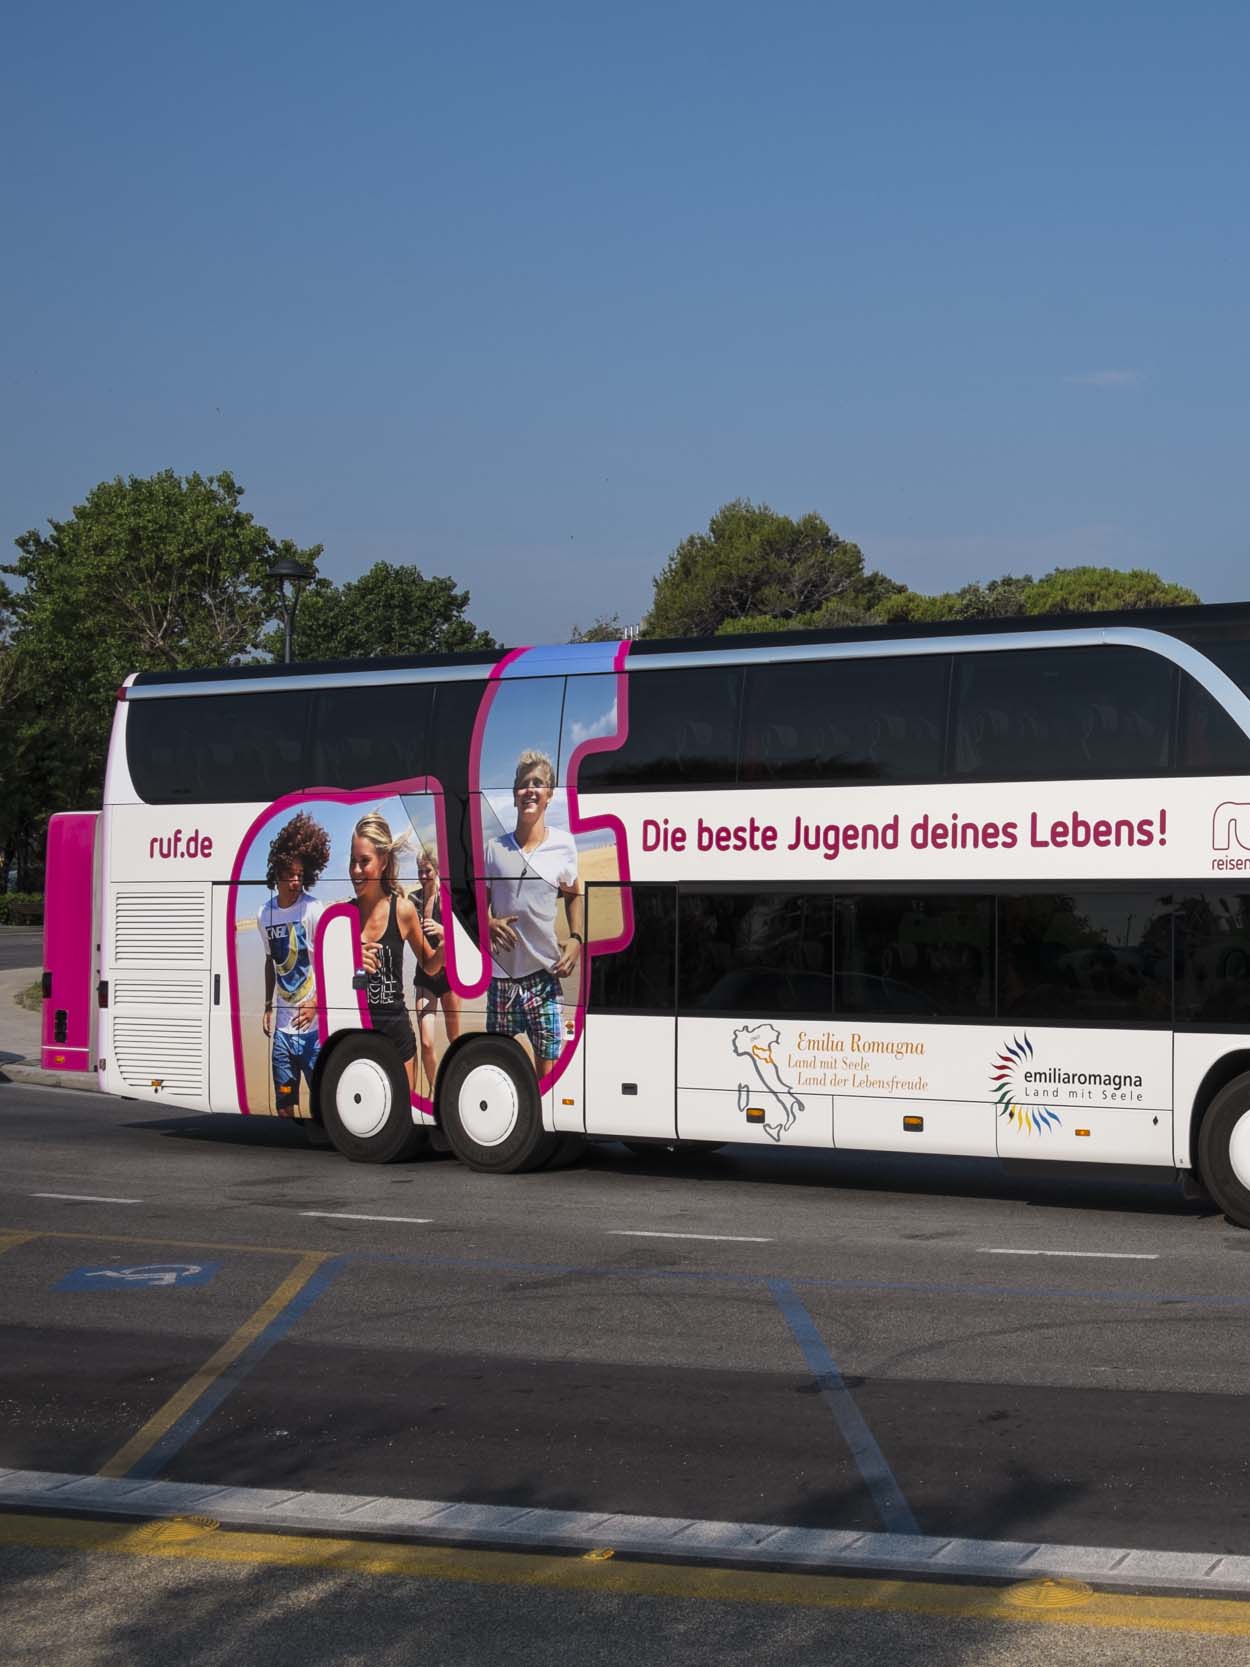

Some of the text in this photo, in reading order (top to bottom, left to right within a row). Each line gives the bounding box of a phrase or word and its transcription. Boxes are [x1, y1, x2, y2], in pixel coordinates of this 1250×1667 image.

[149, 828, 213, 859] ruf.de
[642, 808, 1167, 861] Die beste Jugend deines Lebens!
[797, 1031, 926, 1060] Emilia Romagna
[787, 1053, 870, 1072] Land mit Seele
[797, 1071, 929, 1094] Land der Lebensfreude
[1024, 1067, 1143, 1091] emiliaromagna
[1025, 1087, 1143, 1101] Land mit Seele
